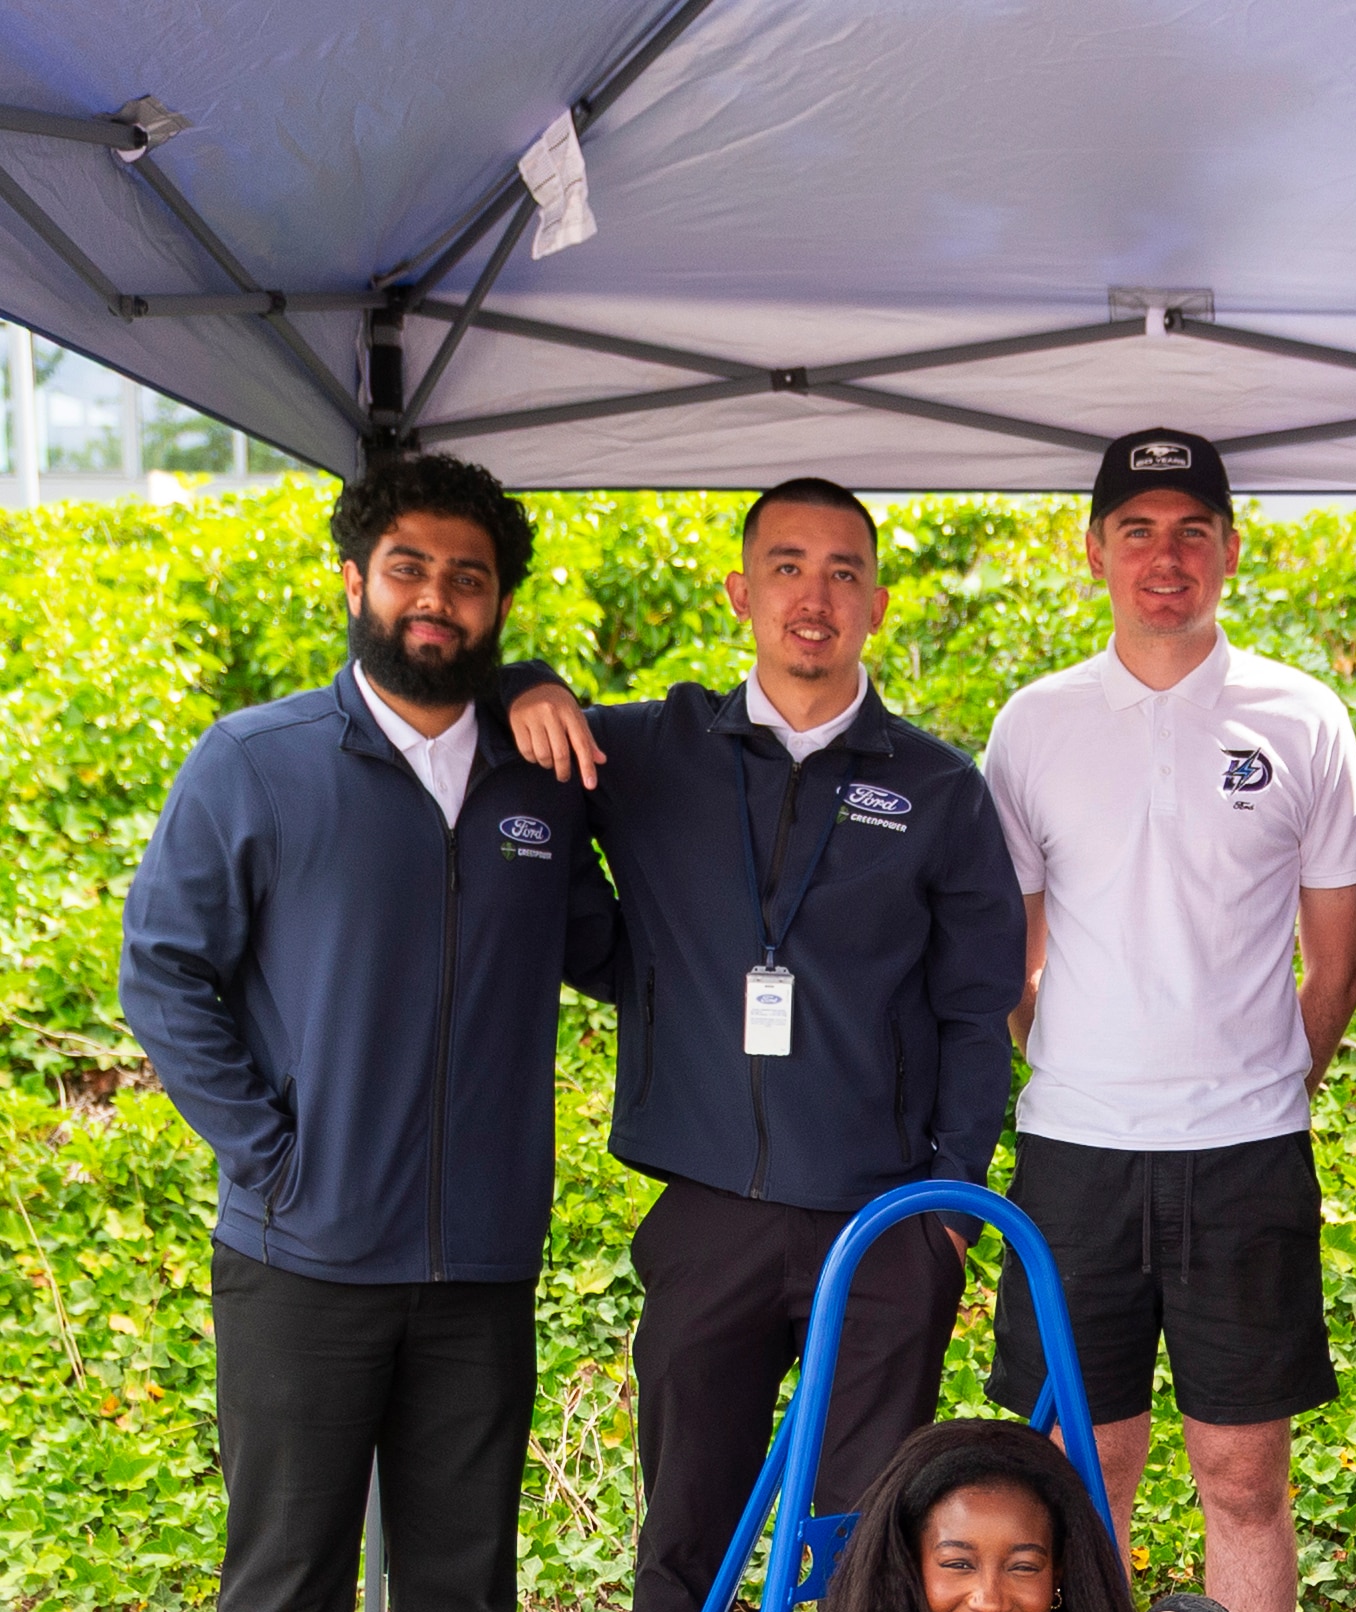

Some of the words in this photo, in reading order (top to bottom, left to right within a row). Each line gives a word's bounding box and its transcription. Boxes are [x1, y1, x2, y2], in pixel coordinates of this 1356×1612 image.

[848, 787, 899, 811] Ford
[511, 819, 544, 840] Ford
[850, 813, 908, 833] GREENPOWER
